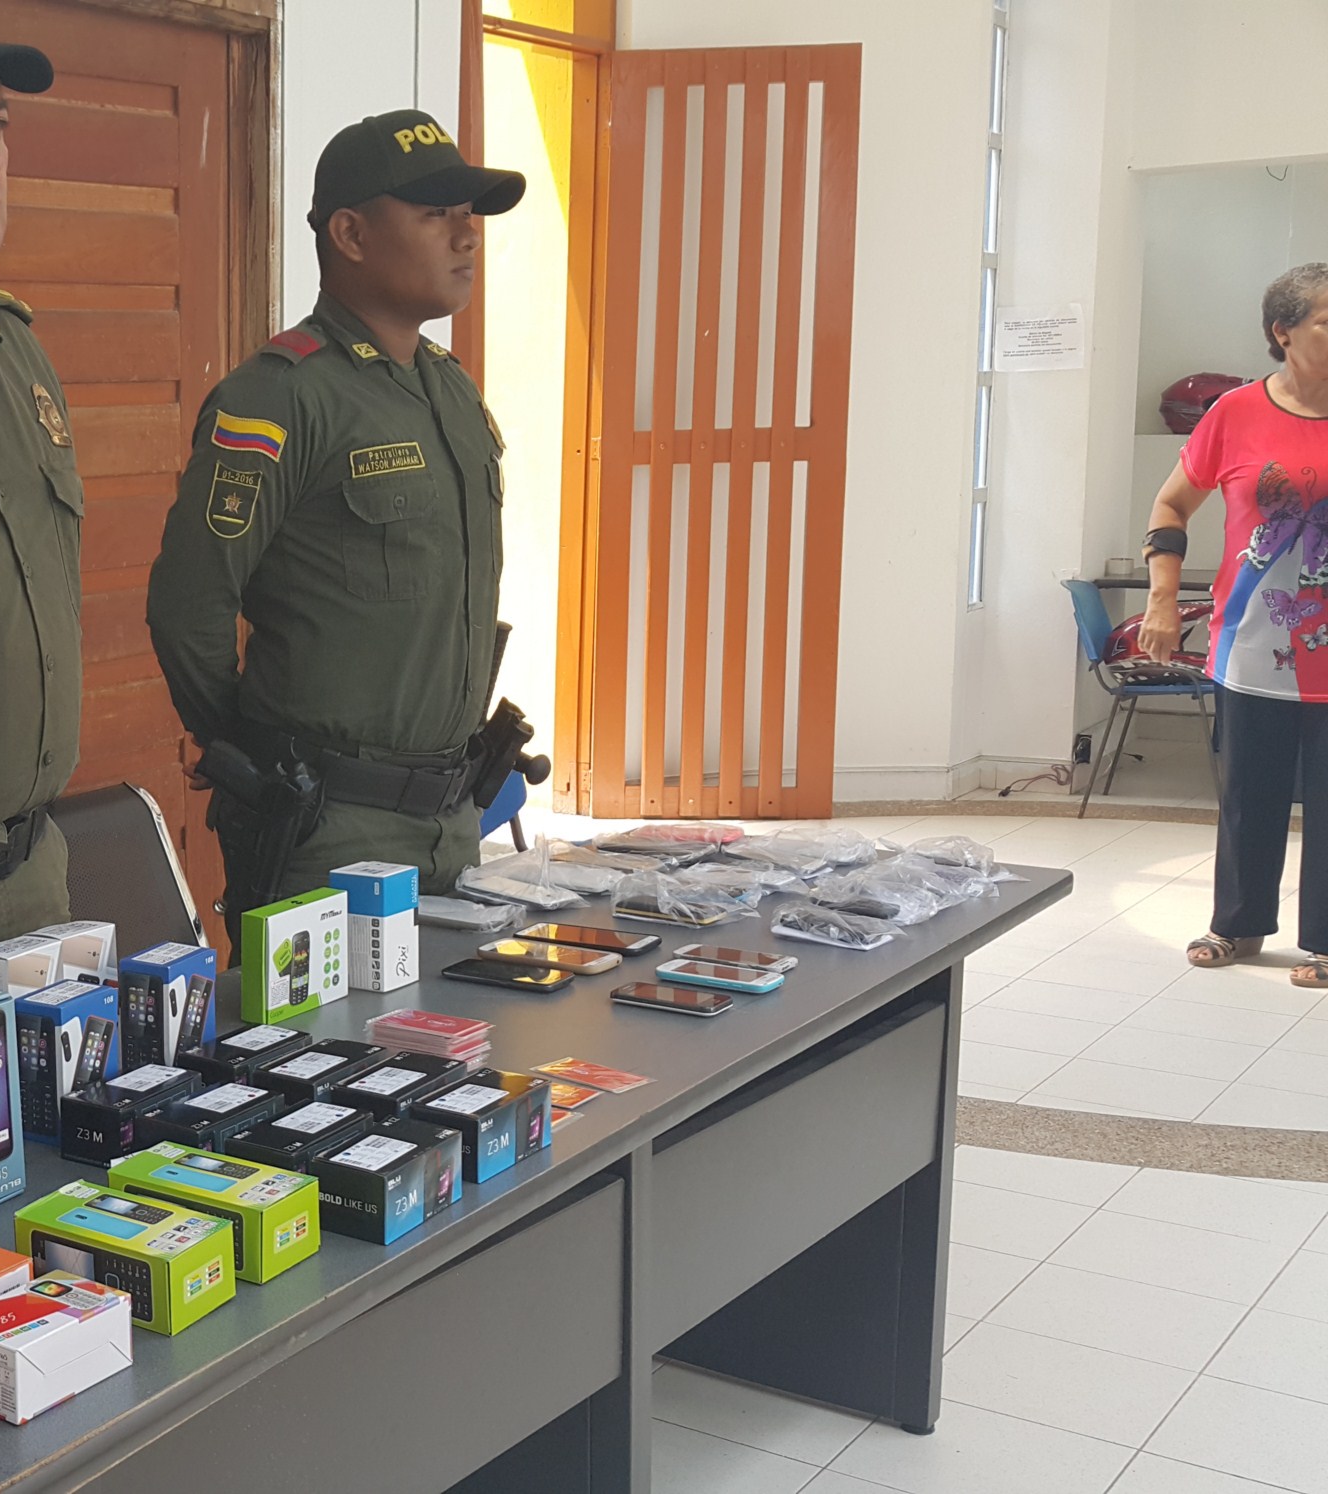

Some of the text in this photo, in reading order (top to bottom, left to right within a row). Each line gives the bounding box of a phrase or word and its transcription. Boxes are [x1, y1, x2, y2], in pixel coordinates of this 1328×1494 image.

[359, 459, 389, 474] WATSON
[222, 470, 254, 485] 01-2016
[395, 946, 410, 977] Pixi
[103, 994, 114, 1005] 108
[76, 1128, 104, 1144] Z3 M
[487, 1132, 510, 1156] Z3 M
[0, 1177, 22, 1193] BLU
[319, 1192, 378, 1214] BOLD LIKE US
[395, 1189, 418, 1216] Z3 M
